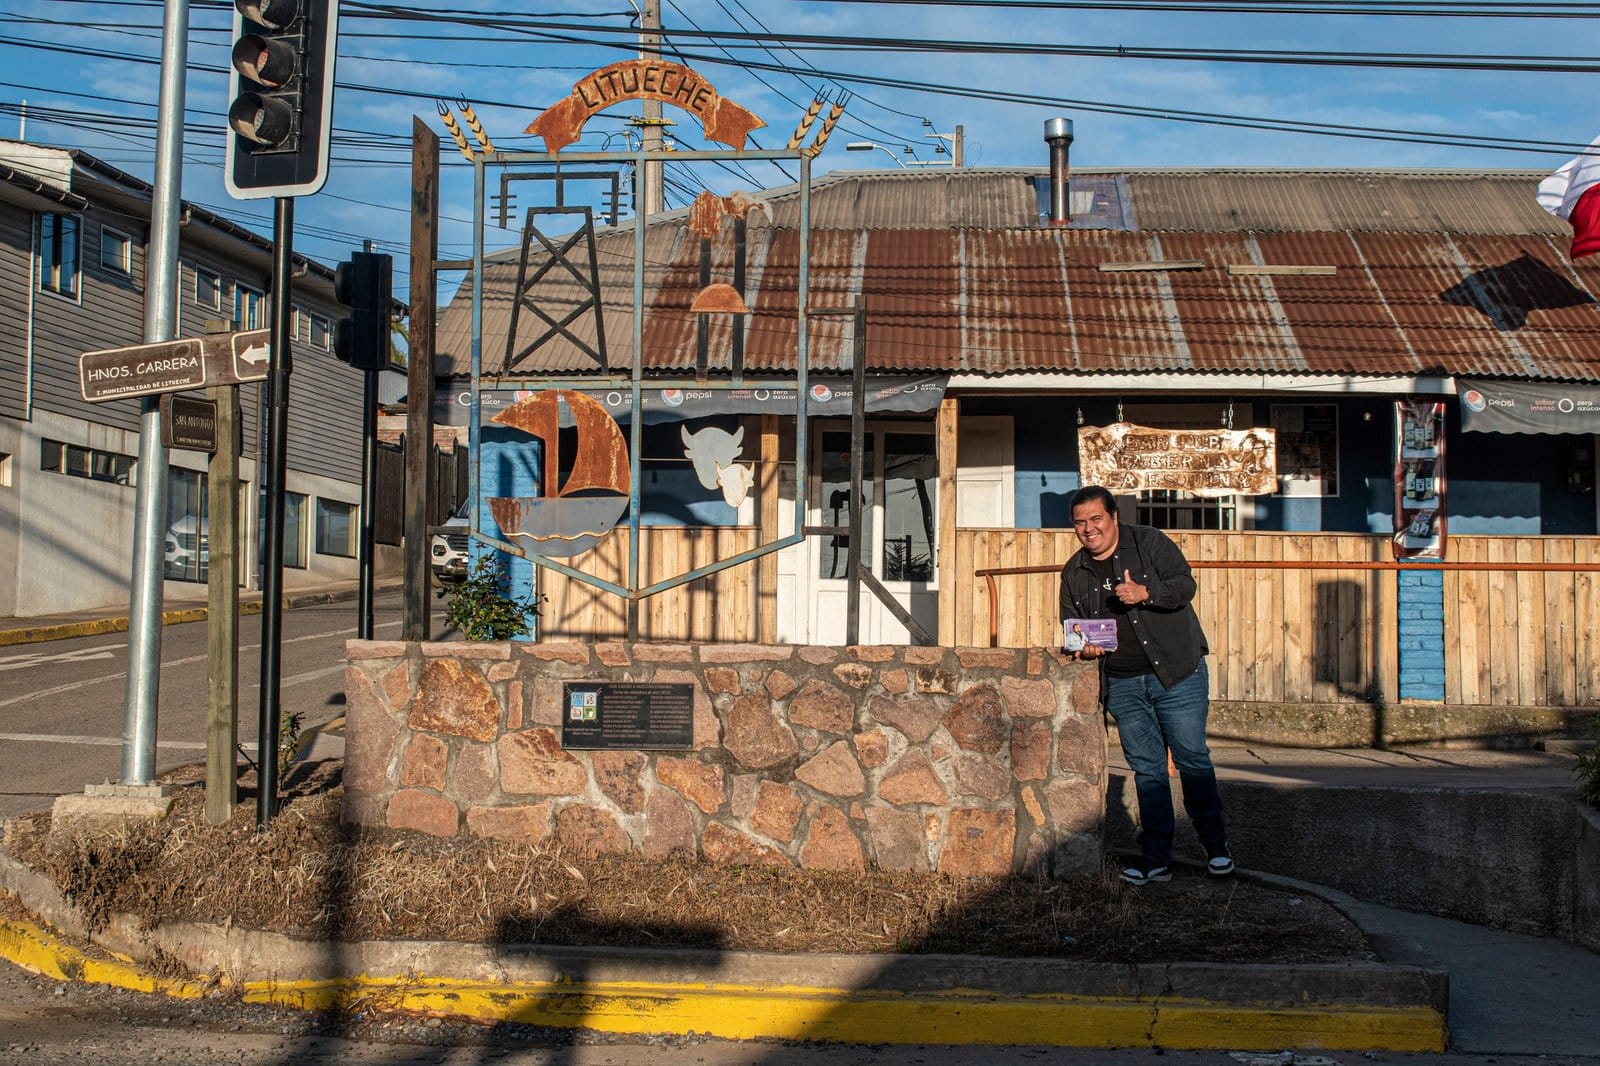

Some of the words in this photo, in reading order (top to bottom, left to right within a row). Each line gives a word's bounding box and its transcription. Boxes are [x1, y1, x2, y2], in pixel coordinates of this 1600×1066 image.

[577, 66, 711, 113] LITUECHE
[88, 365, 133, 381] HNOS.
[136, 356, 199, 374] CARRERA
[686, 390, 712, 401] pepsi
[1488, 398, 1515, 407] pepsi
